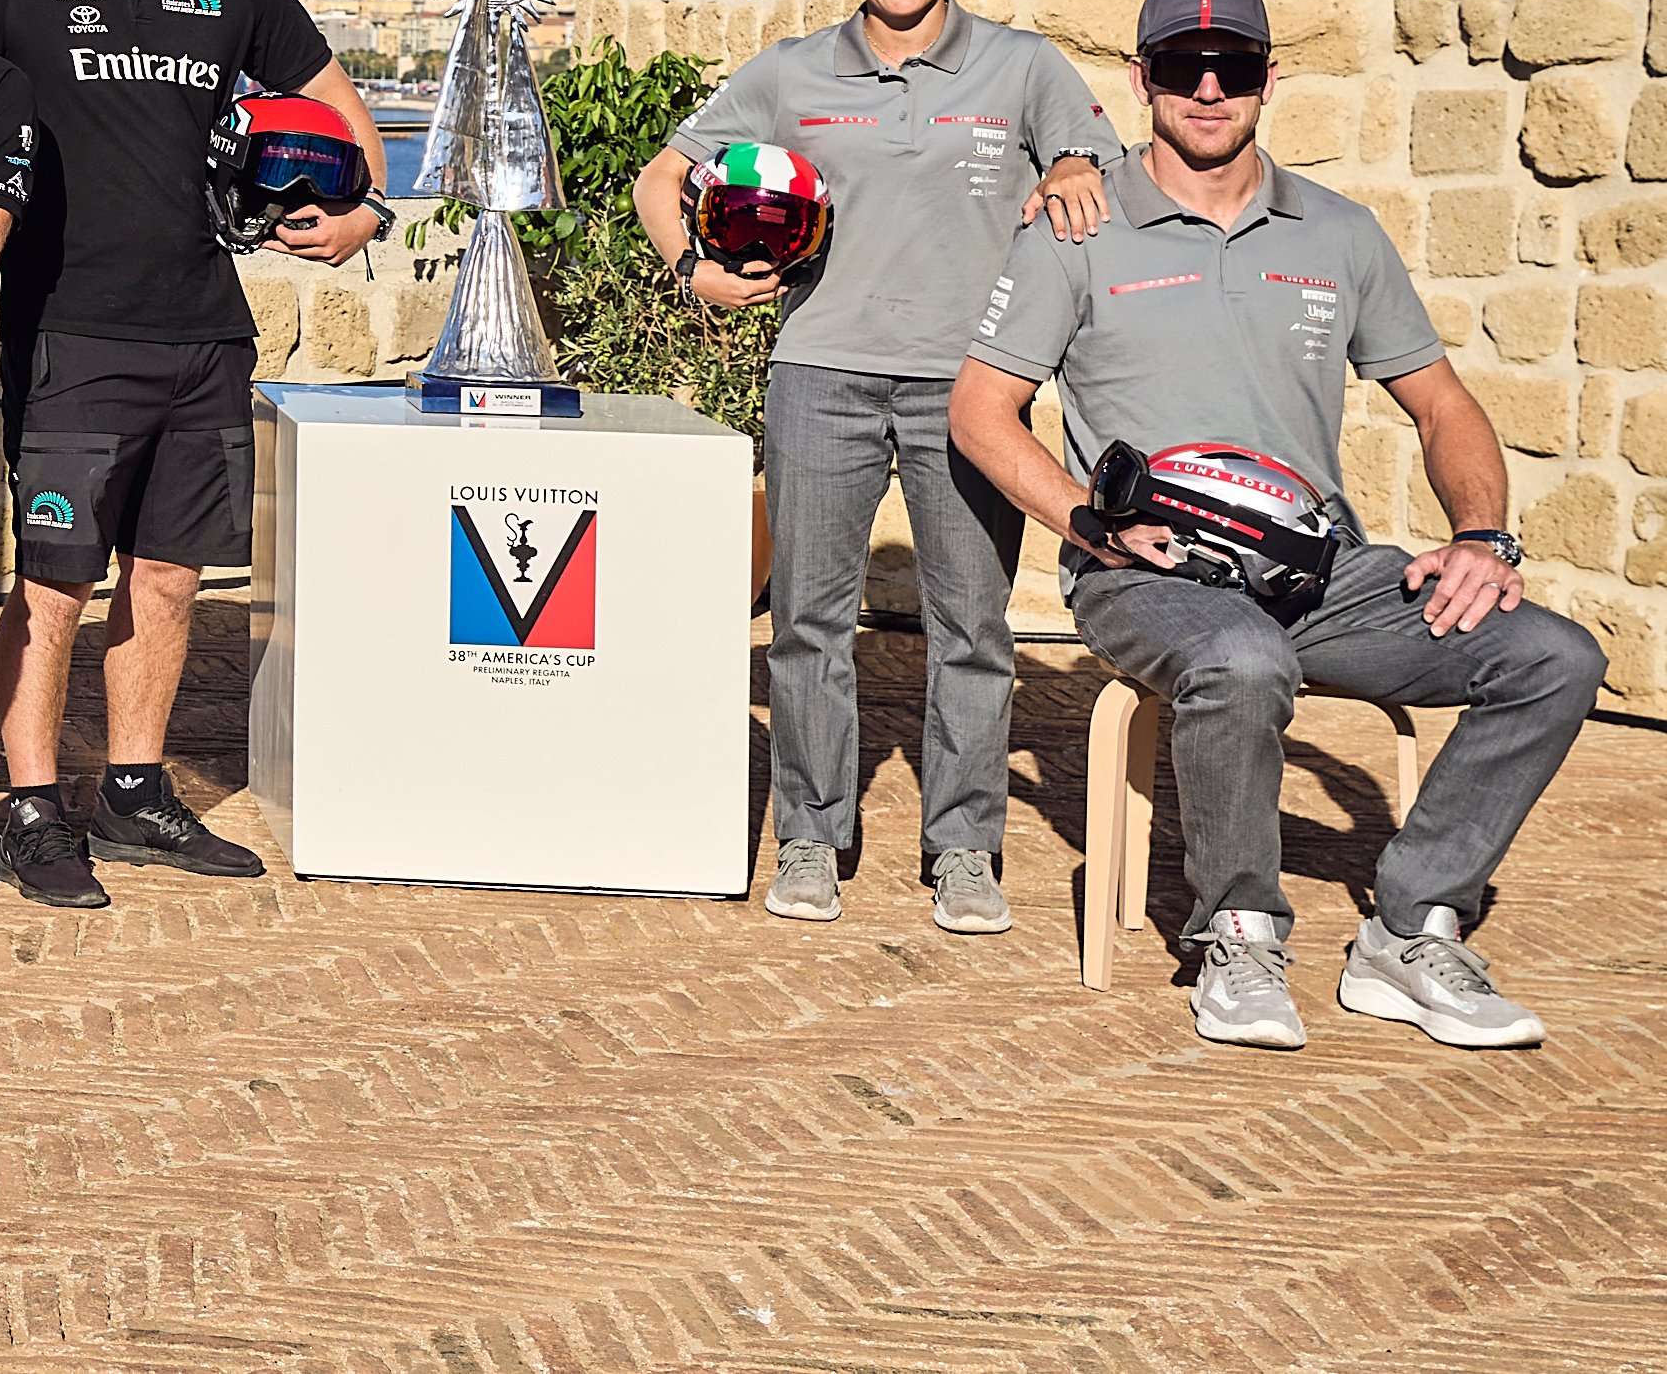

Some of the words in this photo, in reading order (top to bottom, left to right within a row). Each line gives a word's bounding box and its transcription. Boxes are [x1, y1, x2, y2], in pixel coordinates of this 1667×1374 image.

[67, 24, 109, 34] TOYOTA
[69, 46, 220, 91] Emirates
[829, 115, 874, 124] PRADA
[209, 129, 237, 156] MITH
[976, 141, 1005, 159] Unipol
[1281, 275, 1305, 284] LUNA
[1308, 279, 1335, 287] ROSSA
[1173, 462, 1220, 479] LUNA
[1231, 474, 1291, 500] ROSSA
[450, 485, 508, 502] LOUIS
[514, 487, 598, 505] VUITTON
[1158, 495, 1224, 521] PRADA
[448, 650, 477, 662] 38TH
[481, 651, 561, 666] AMERICA'S
[566, 655, 596, 667] CUP
[473, 665, 530, 676] PRELIMINARY
[532, 669, 571, 678] REGATTA
[491, 676, 527, 686] NAPLES,
[529, 678, 551, 687] ITALY
